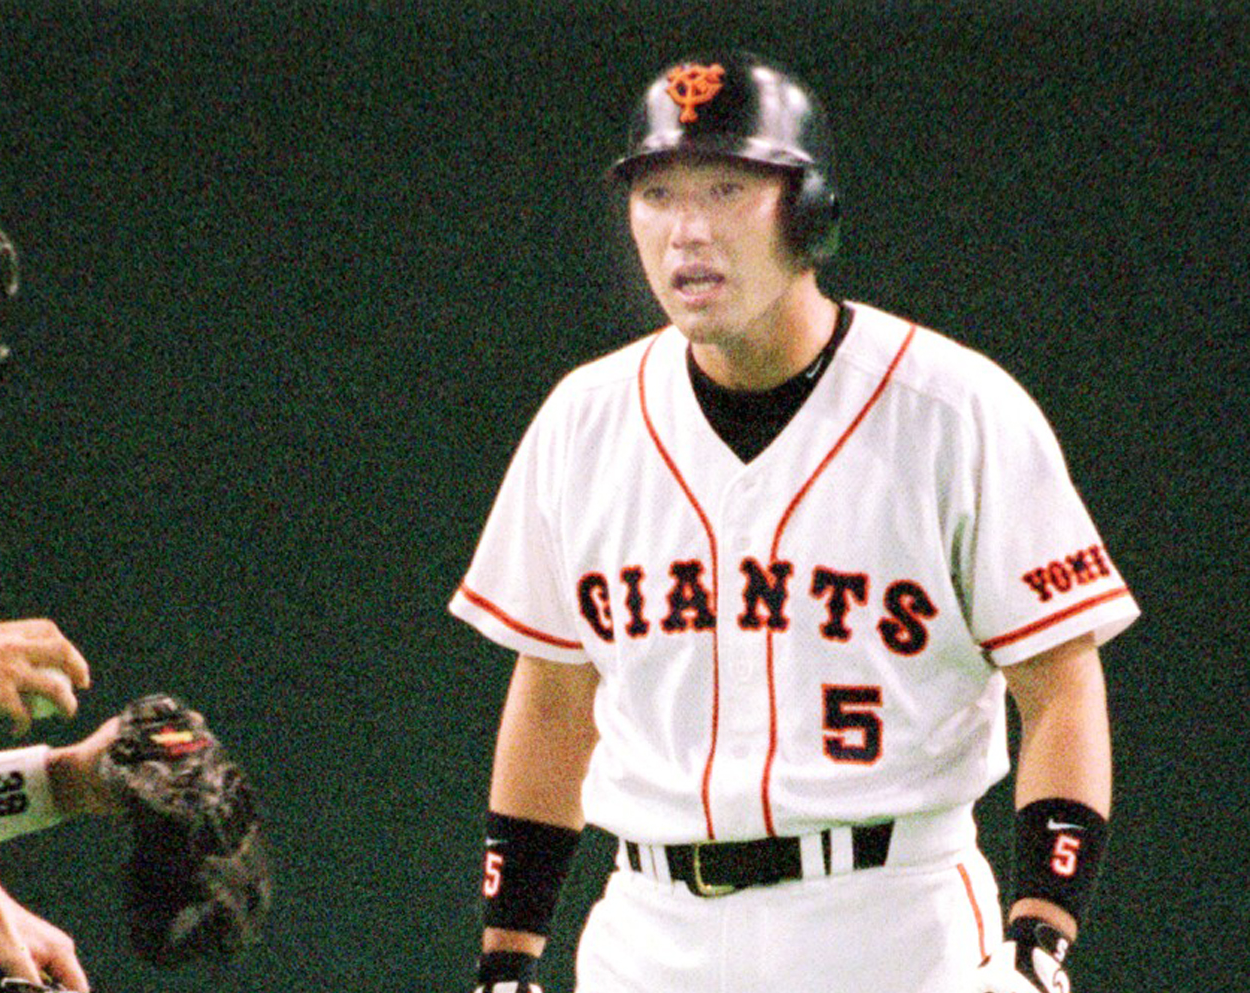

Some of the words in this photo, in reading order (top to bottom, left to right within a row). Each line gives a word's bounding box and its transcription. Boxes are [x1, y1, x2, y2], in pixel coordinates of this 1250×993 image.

[577, 556, 938, 656] GIANTS
[821, 683, 883, 766] 5
[483, 849, 503, 898] 5
[1052, 833, 1080, 876] 5
